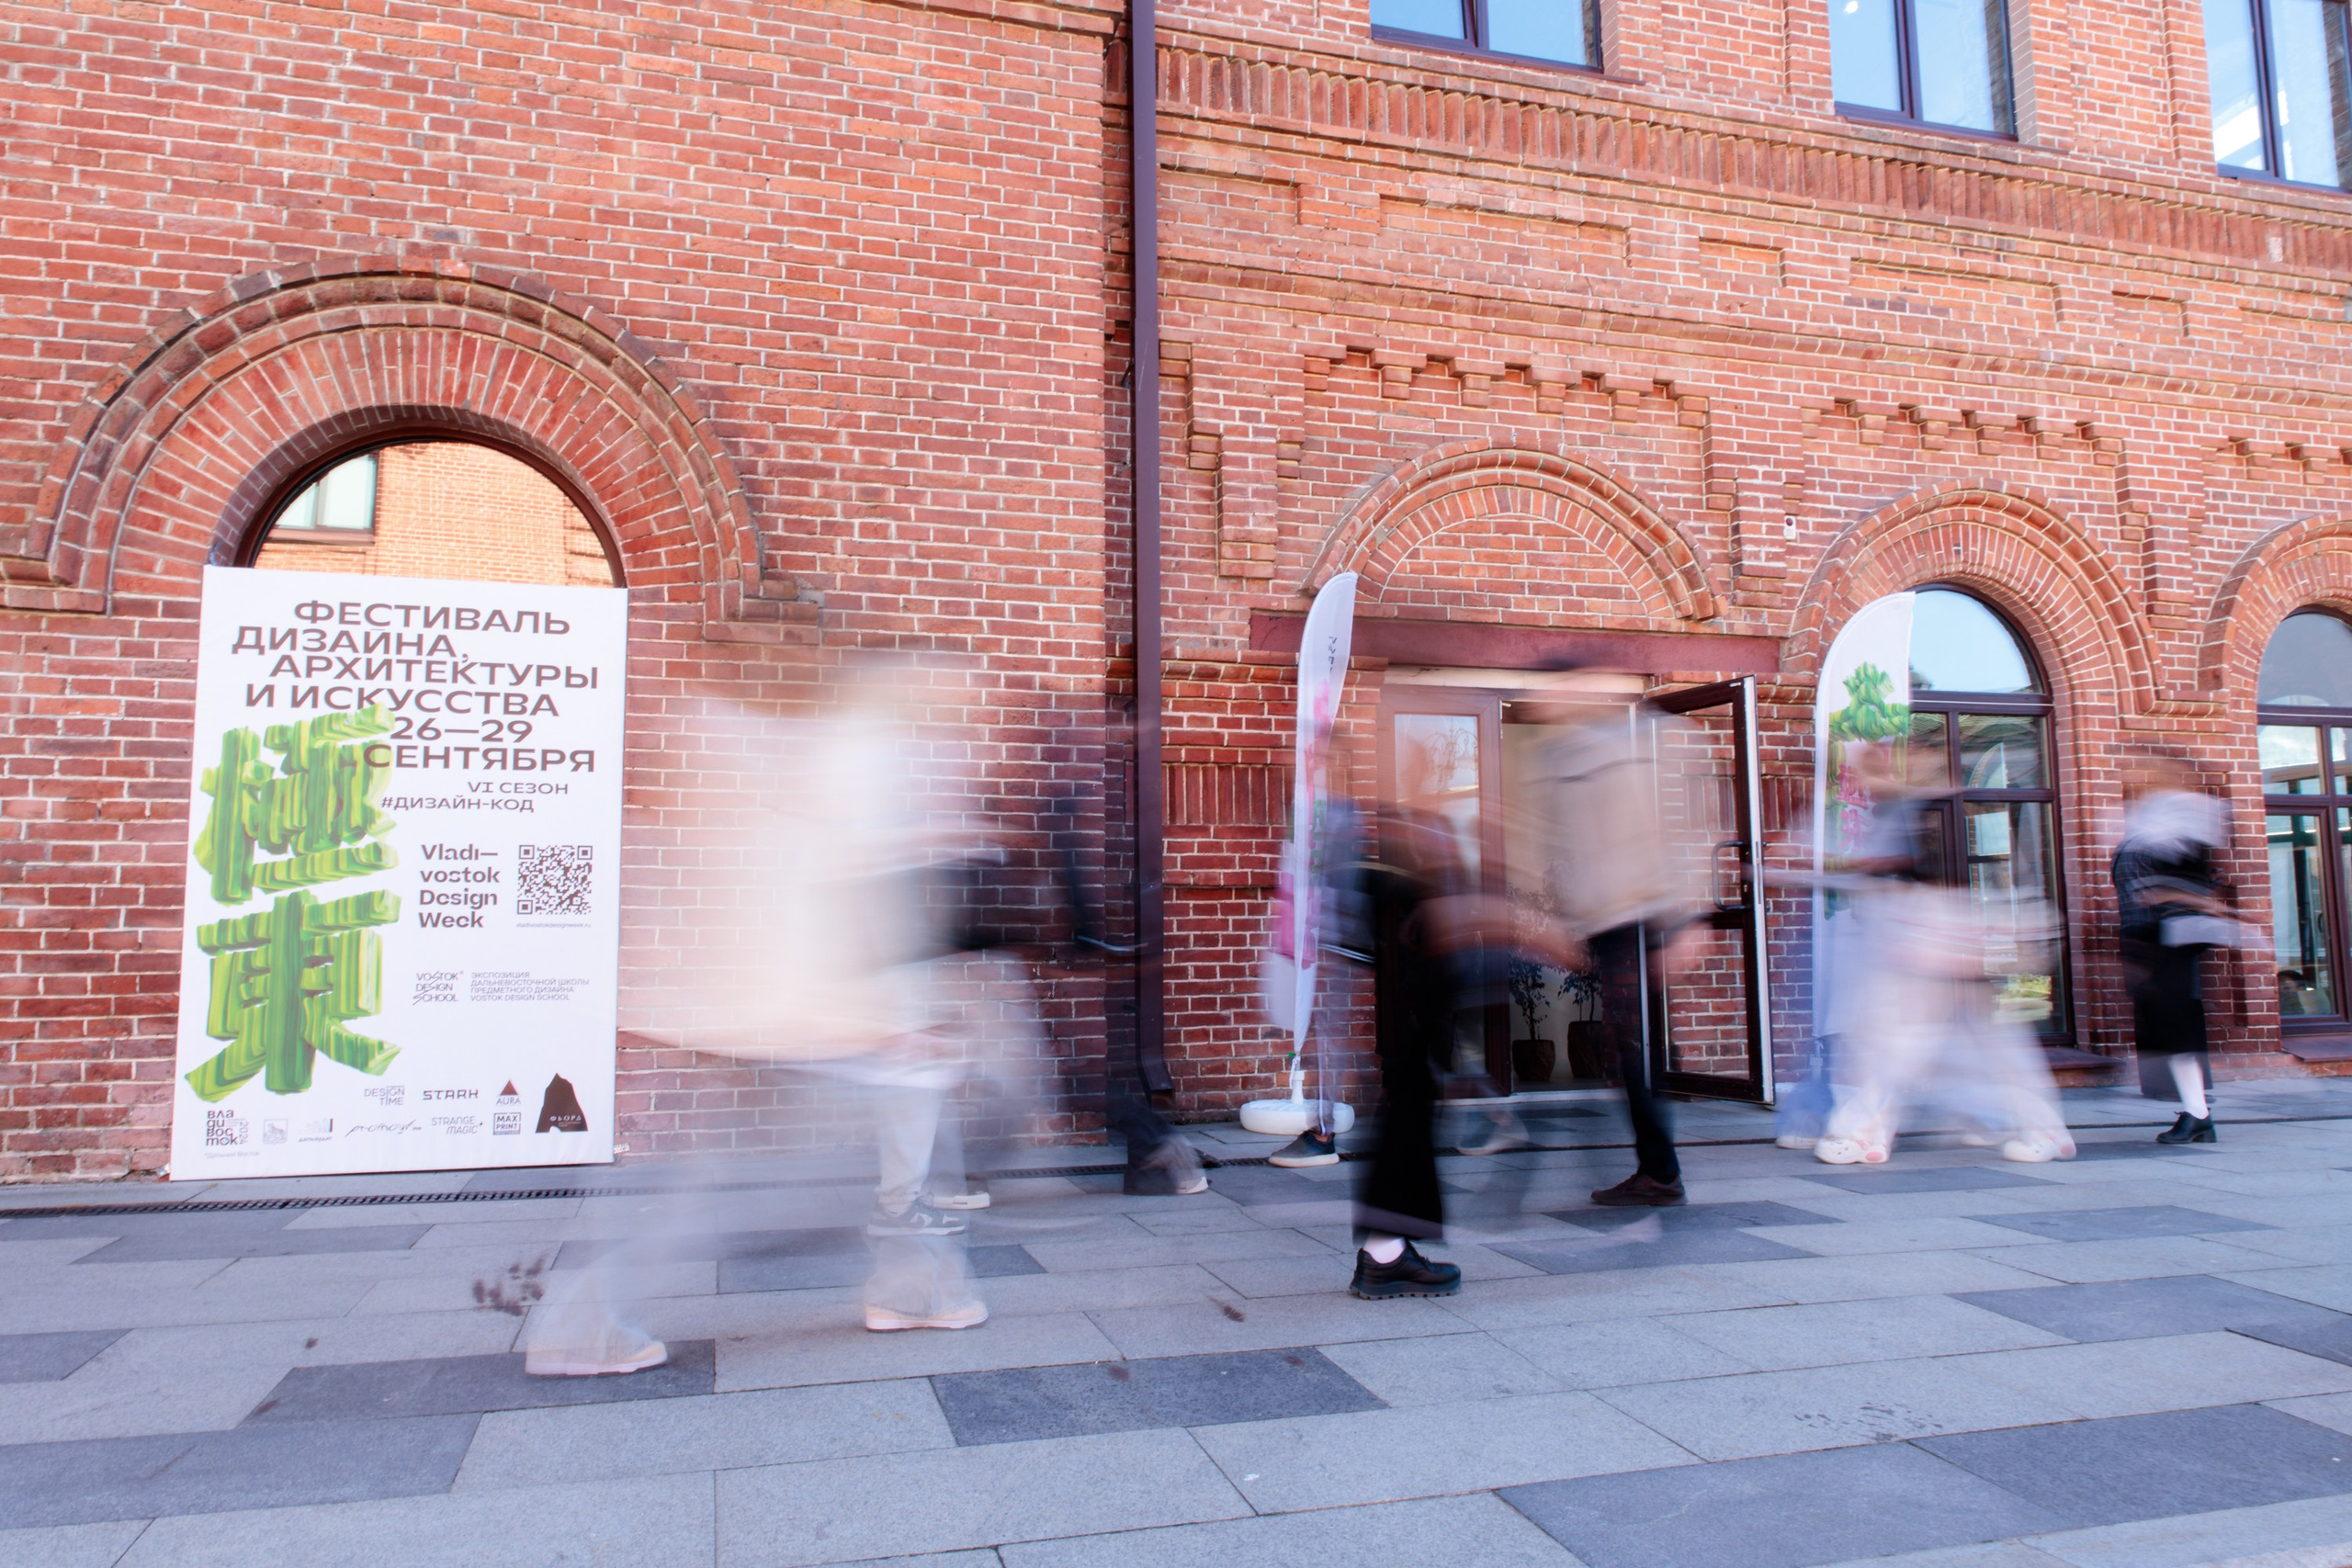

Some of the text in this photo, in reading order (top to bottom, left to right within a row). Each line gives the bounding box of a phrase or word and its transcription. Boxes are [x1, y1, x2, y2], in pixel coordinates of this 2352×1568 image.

[294, 600, 571, 635] ФЕСТИВАЛЬ
[232, 626, 469, 663] ДИЗАЙНА,
[269, 654, 599, 689] АРХИТЕКТУРЫ
[245, 683, 560, 717] И ИСКУССТВА
[363, 744, 595, 773] СЕНТЯБРЯ
[468, 782, 569, 795] VI СЕЗОН
[381, 795, 535, 813] #ДИЗАЙН-КОД
[420, 866, 501, 883] vostok
[419, 887, 498, 910] Design
[419, 911, 484, 928] Week
[416, 971, 458, 981] VOSTOK
[470, 978, 557, 987] ДАЛЬНЕВОСТОЧНОЙ
[471, 972, 530, 980] ЭКСПОЗИЦИЯ
[415, 983, 453, 992] DESIGN
[413, 993, 459, 1006] SCHOOL
[364, 1087, 405, 1098] DESIGN
[379, 1097, 404, 1106] TIME
[432, 1116, 476, 1126] STRANGE
[447, 1125, 479, 1135] MAGIC
